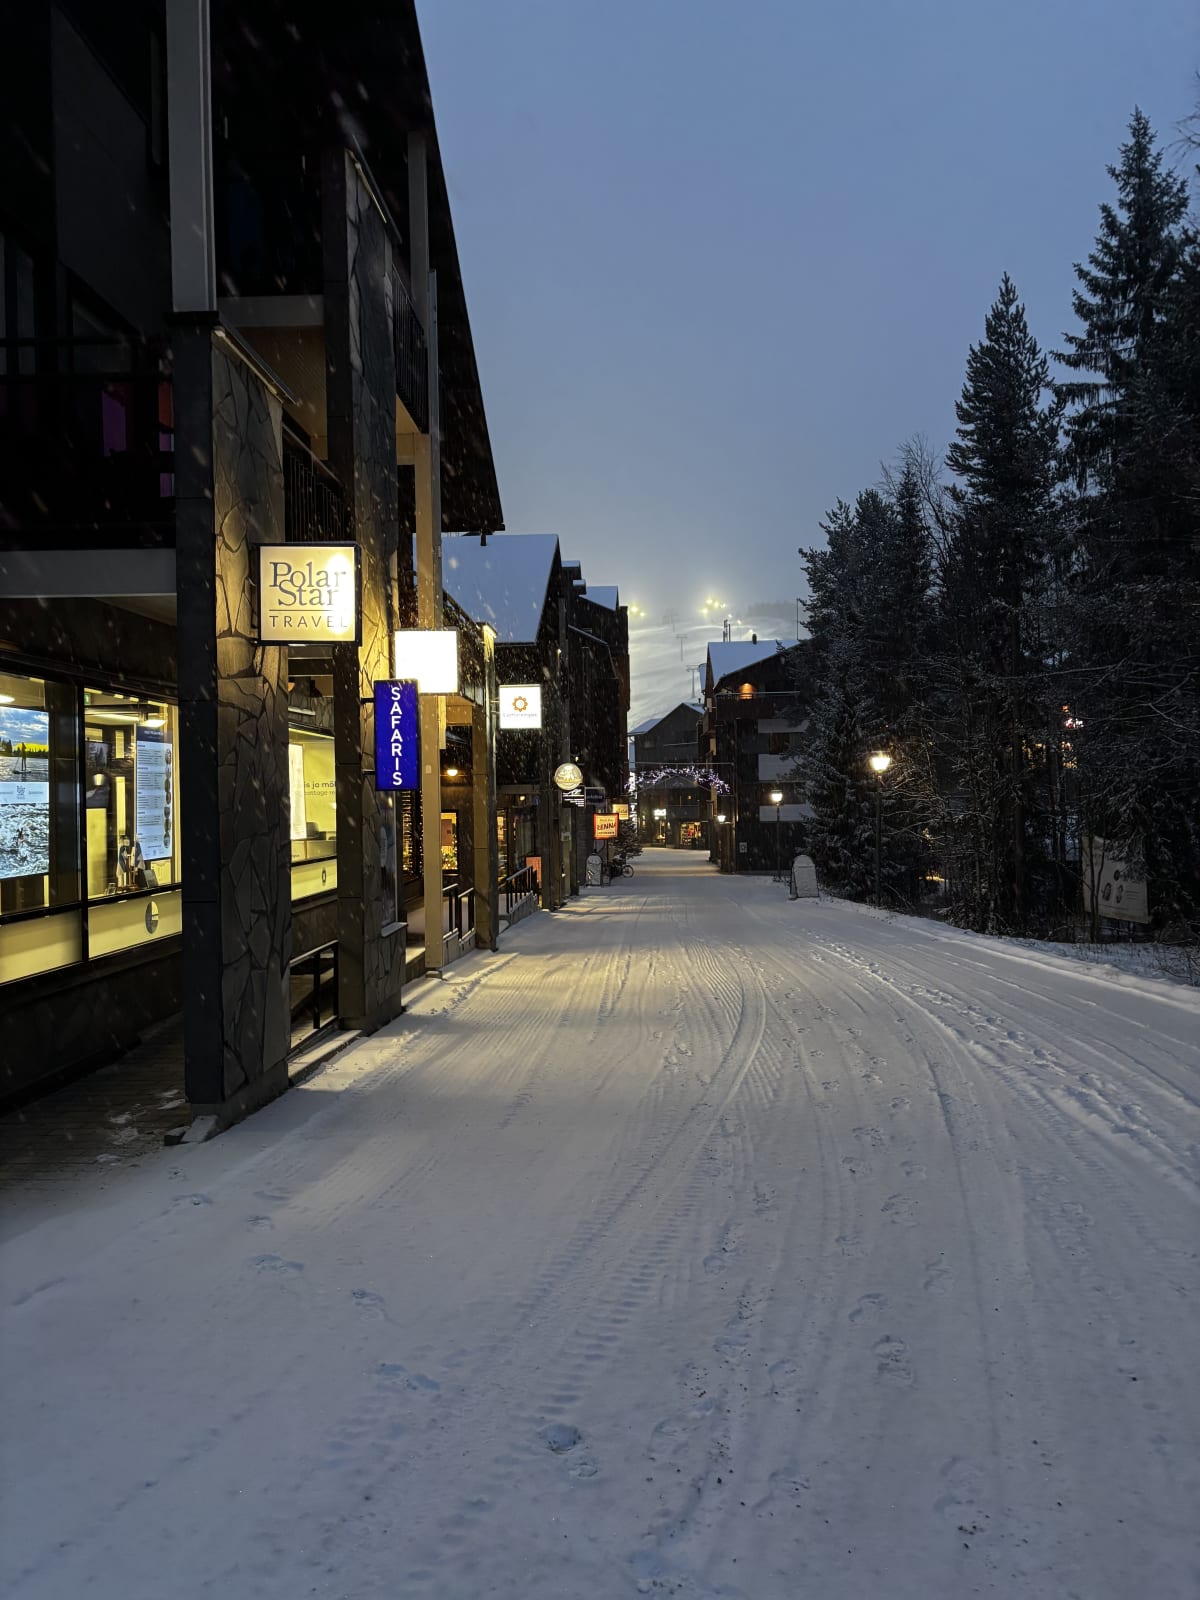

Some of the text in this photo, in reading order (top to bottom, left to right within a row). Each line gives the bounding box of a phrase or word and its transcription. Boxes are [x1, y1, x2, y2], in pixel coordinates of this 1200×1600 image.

[269, 561, 347, 588] Polar
[278, 579, 340, 606] Star
[269, 615, 348, 628] TRAVEL
[390, 687, 403, 786] SAFARIS
